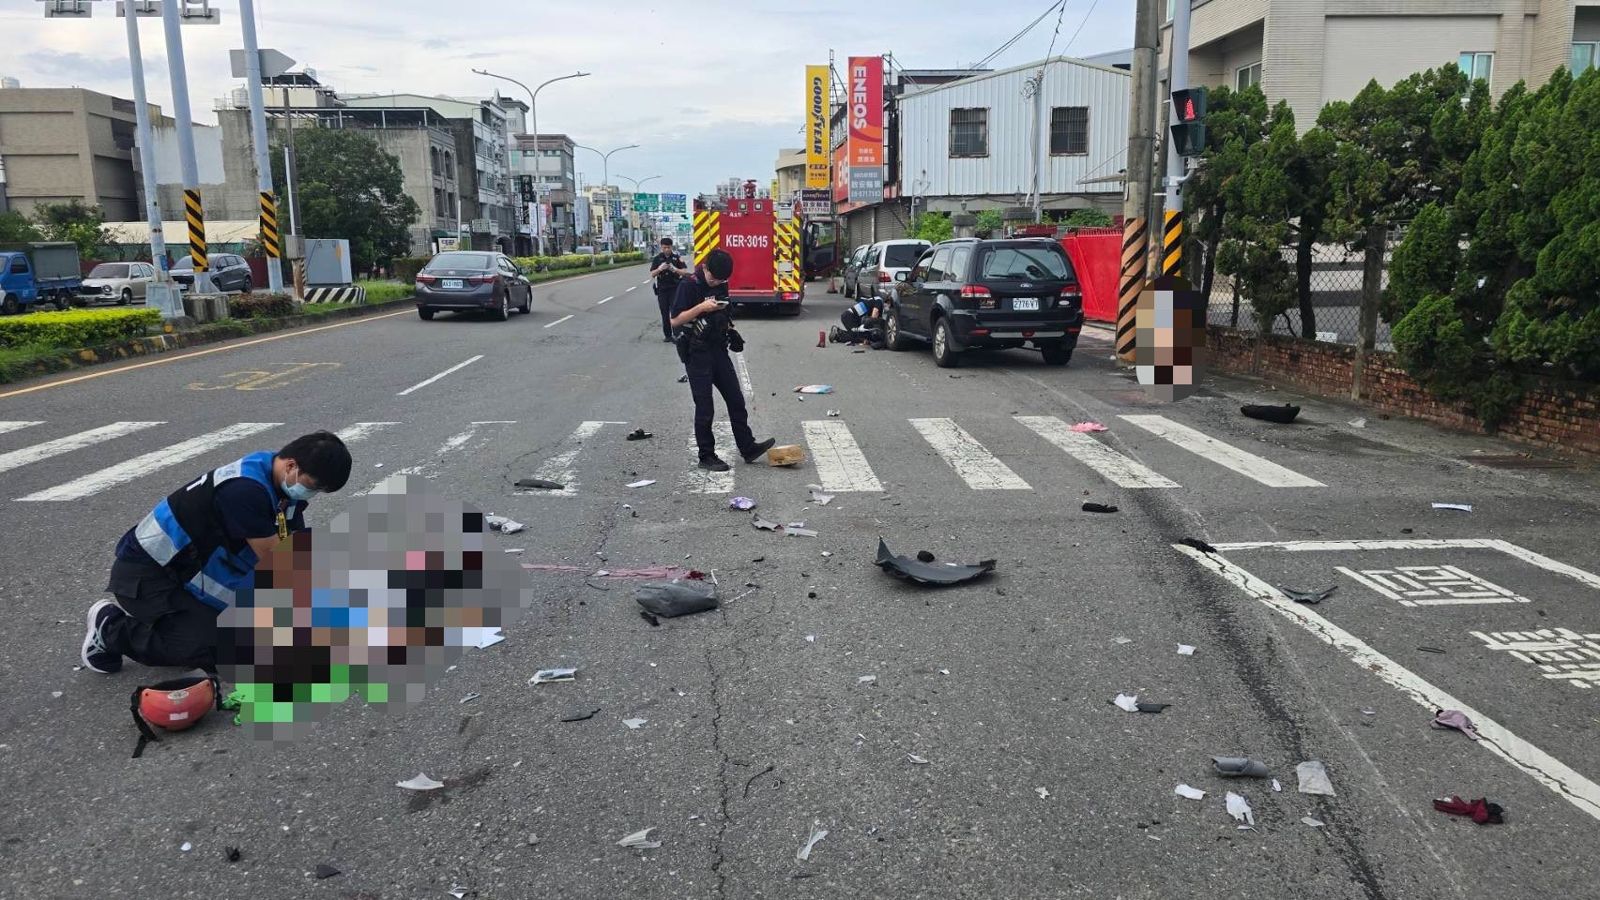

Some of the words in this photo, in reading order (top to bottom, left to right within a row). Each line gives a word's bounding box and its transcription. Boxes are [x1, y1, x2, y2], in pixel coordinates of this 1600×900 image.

[812, 76, 825, 155] GOODYEAR
[854, 66, 867, 129] ENEOS
[726, 234, 768, 248] KER-3015
